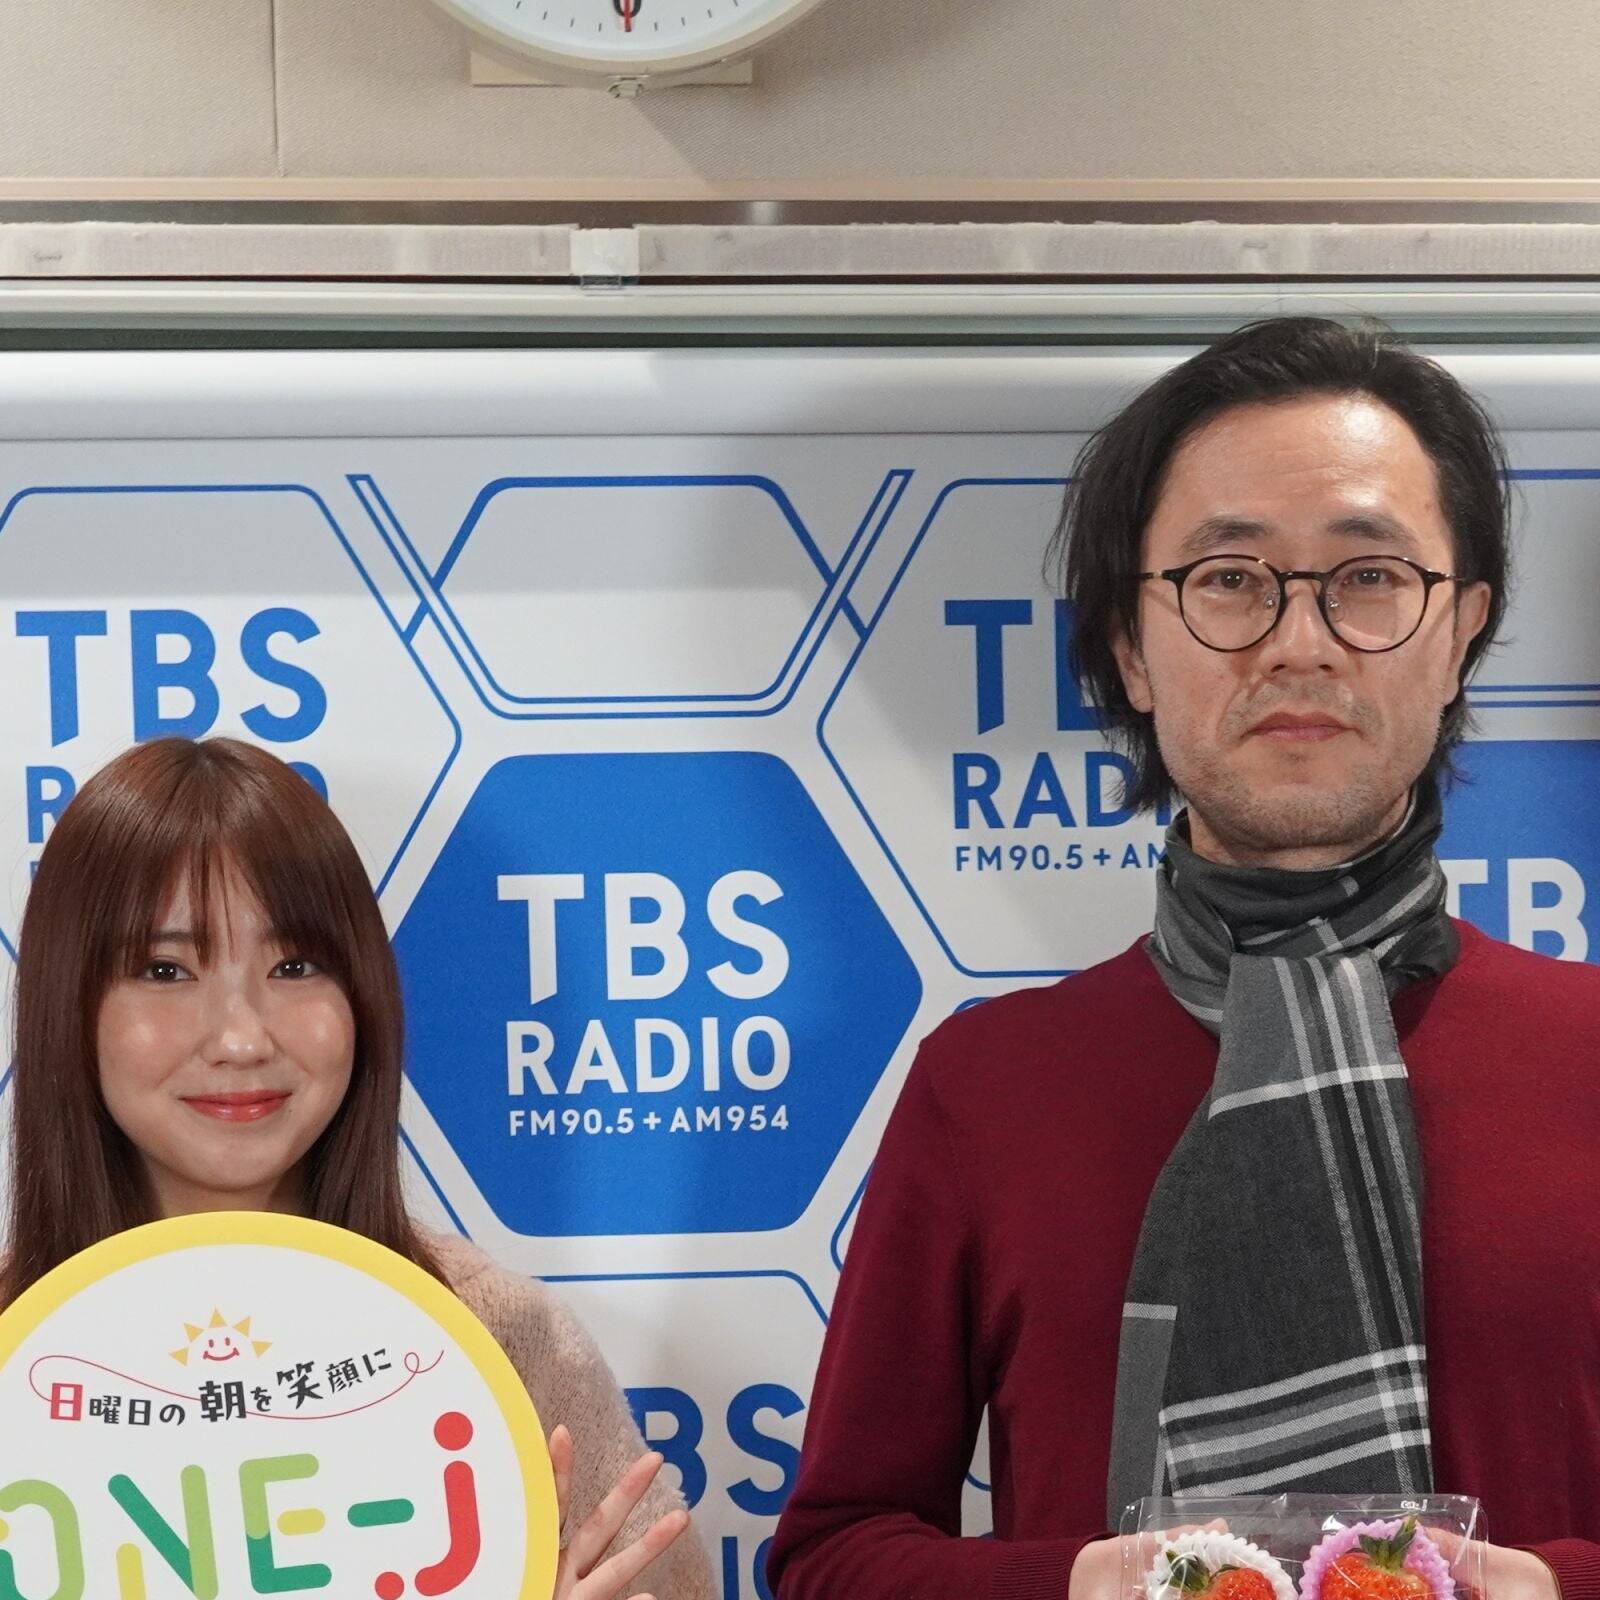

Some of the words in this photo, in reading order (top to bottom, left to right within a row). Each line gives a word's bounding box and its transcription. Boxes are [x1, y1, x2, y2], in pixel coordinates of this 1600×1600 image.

[16, 607, 328, 747] TBS
[953, 751, 1171, 829] RAD
[497, 869, 791, 1004] TBS
[506, 1015, 791, 1096] RADIO
[50, 1348, 393, 1427] 日曜日の朝を笑顔に
[625, 1384, 806, 1516] BS
